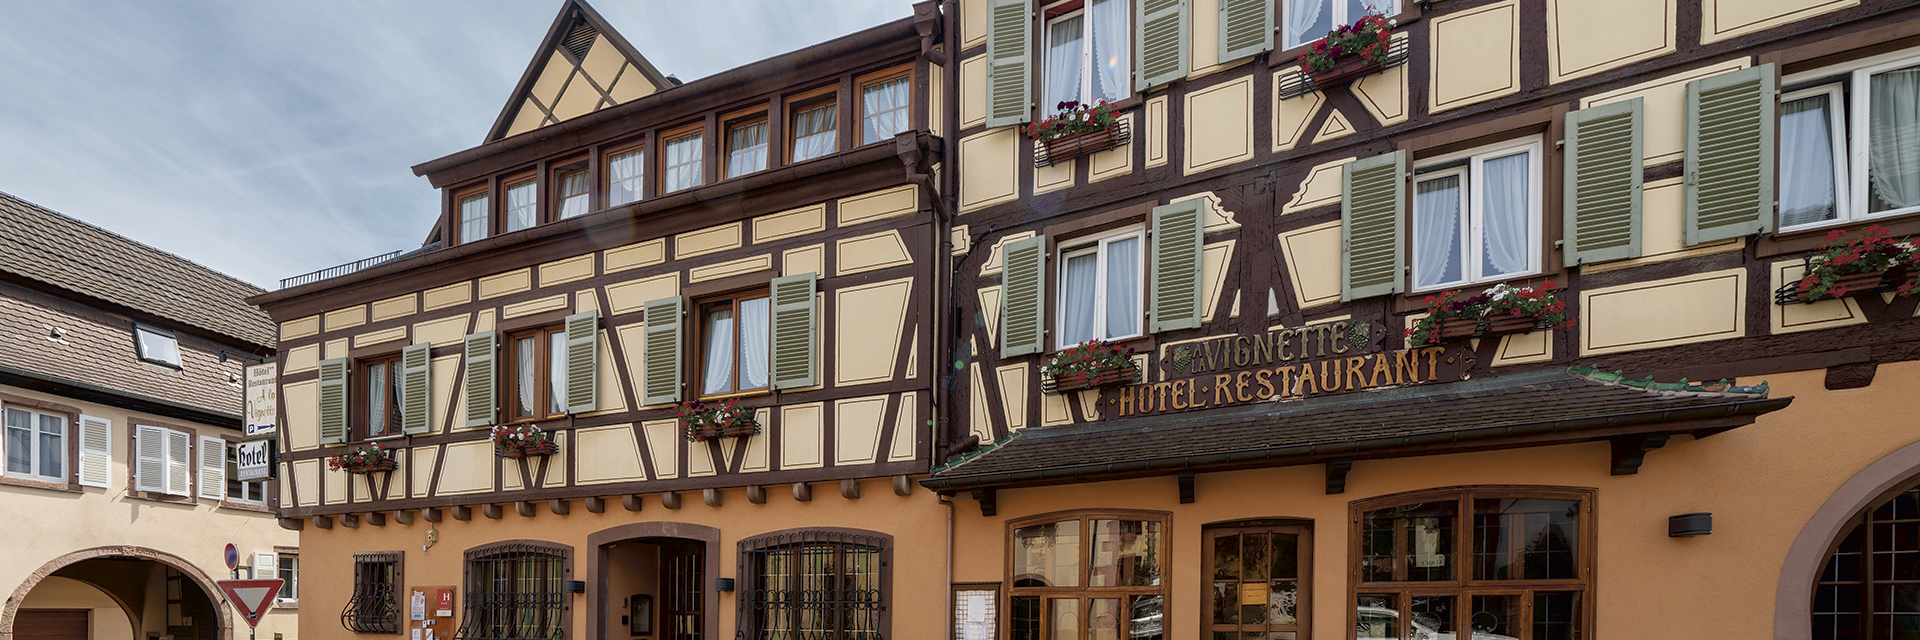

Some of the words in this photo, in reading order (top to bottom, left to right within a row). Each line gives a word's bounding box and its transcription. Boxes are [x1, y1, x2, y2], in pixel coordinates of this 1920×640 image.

[1202, 321, 1349, 371] VIGNETTE
[1119, 378, 1207, 417] HOTEL
[1214, 346, 1446, 406] RESTAURANT
[443, 593, 450, 601] H
